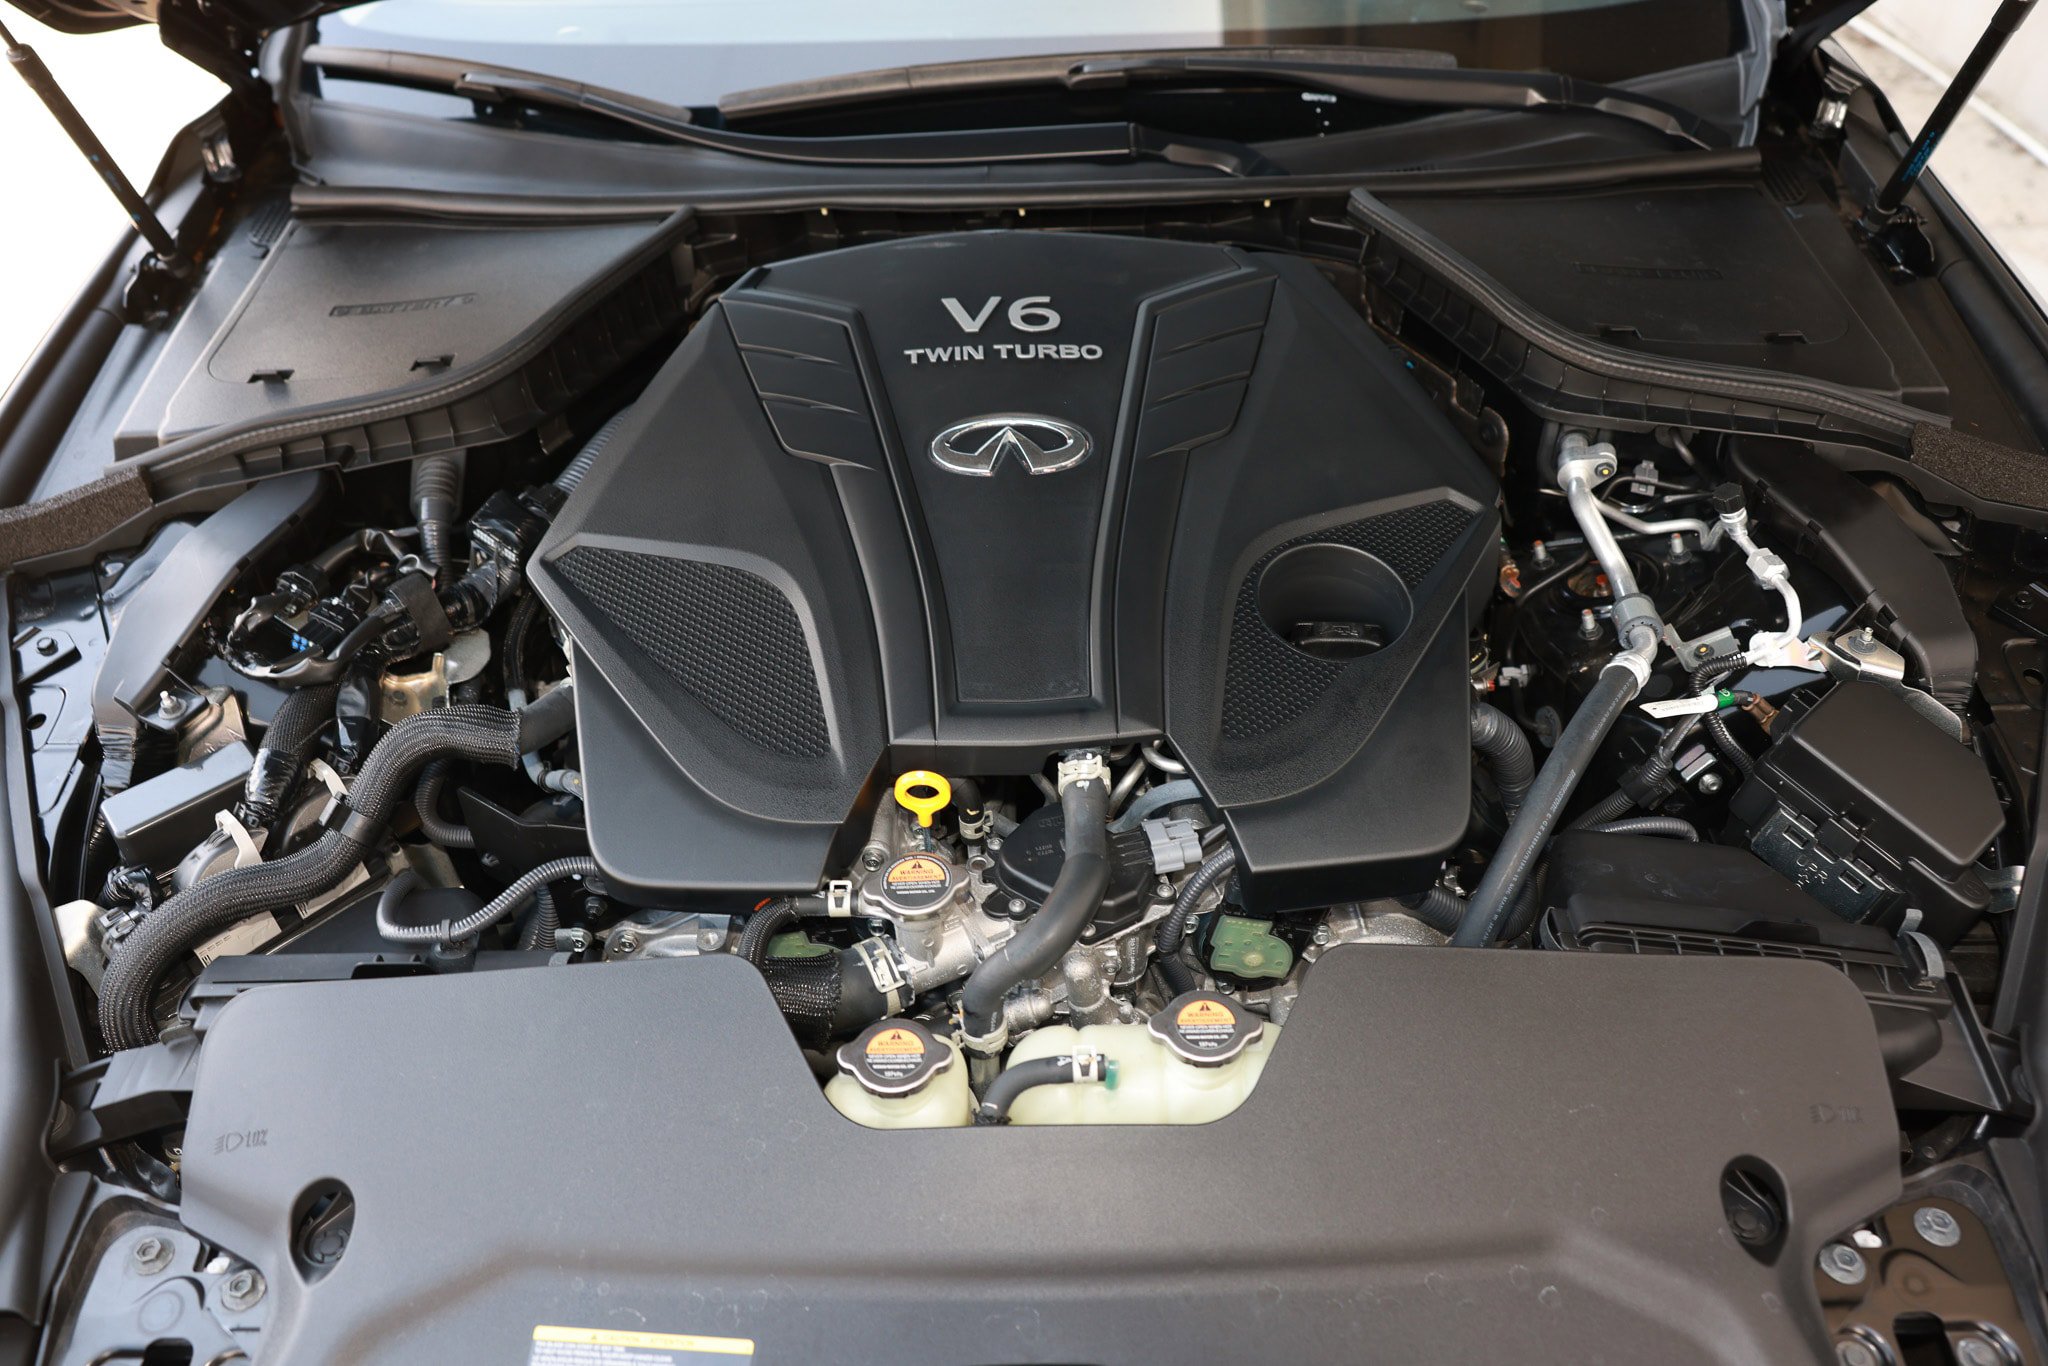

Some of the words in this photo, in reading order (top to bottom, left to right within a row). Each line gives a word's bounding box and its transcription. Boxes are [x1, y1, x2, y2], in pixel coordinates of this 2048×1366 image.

[941, 296, 1061, 333] V6
[904, 345, 985, 364] TWIN
[993, 344, 1103, 360] TURBO
